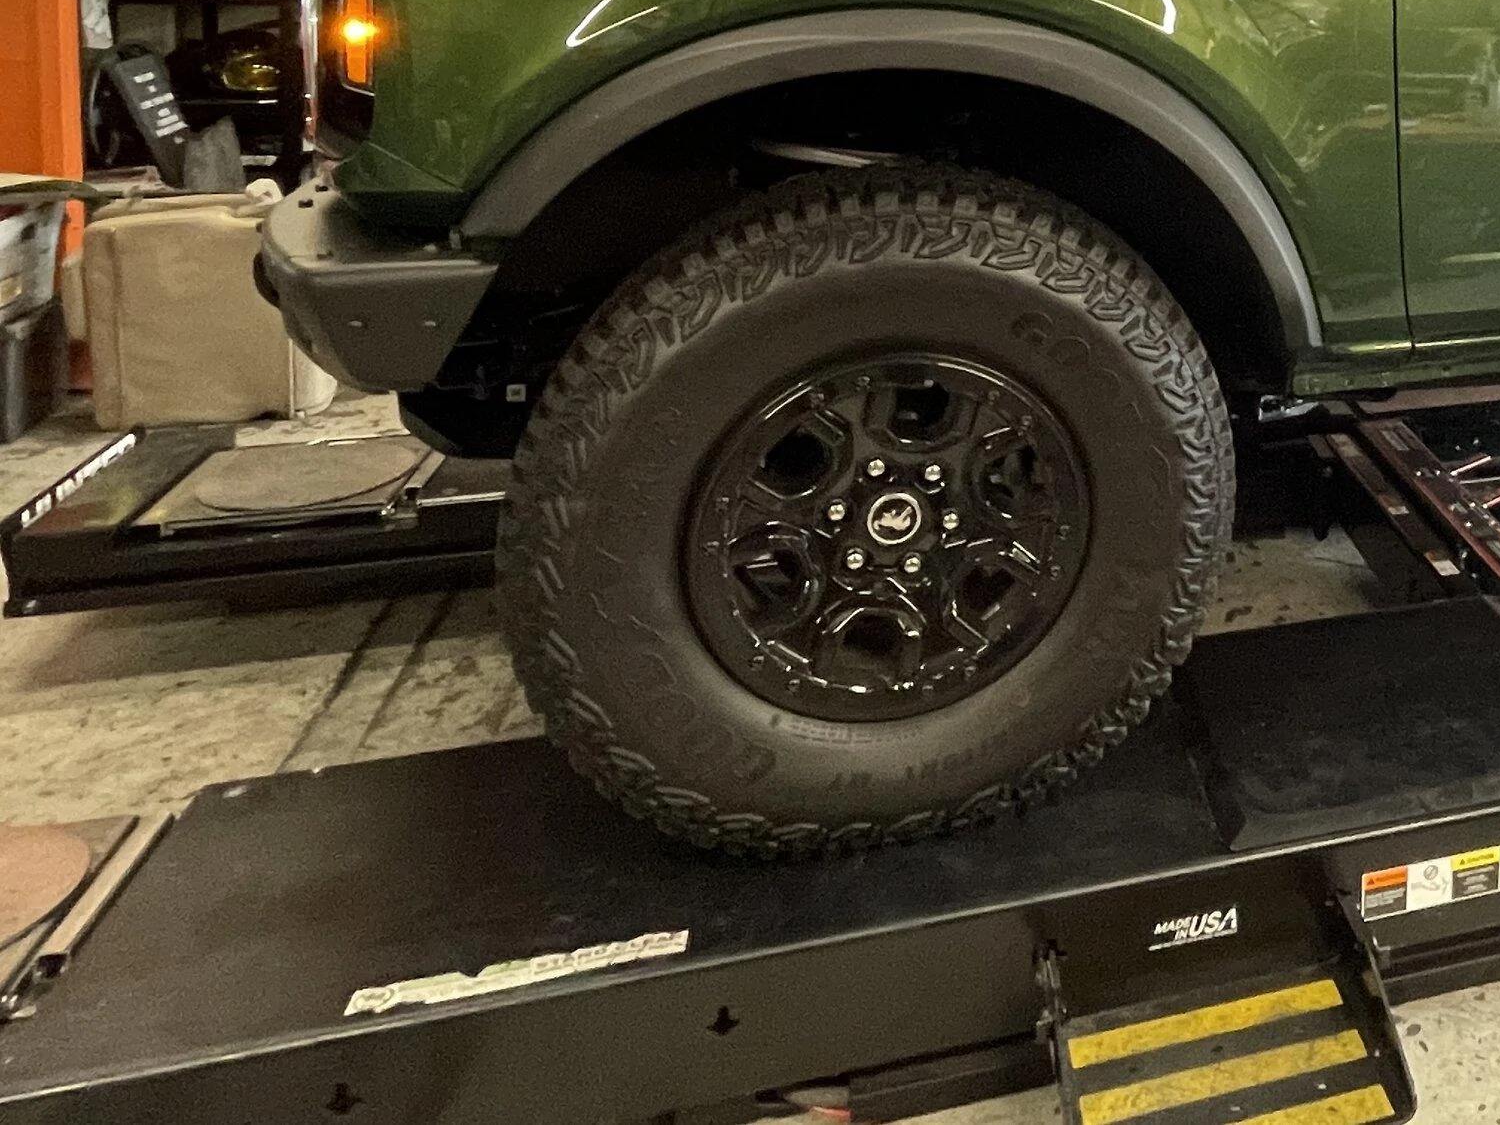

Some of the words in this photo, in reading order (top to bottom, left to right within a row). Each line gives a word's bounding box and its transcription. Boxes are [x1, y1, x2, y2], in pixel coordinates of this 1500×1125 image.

[1154, 916, 1192, 935] MADE
[1174, 929, 1189, 940] IN
[1189, 907, 1238, 937] USA
